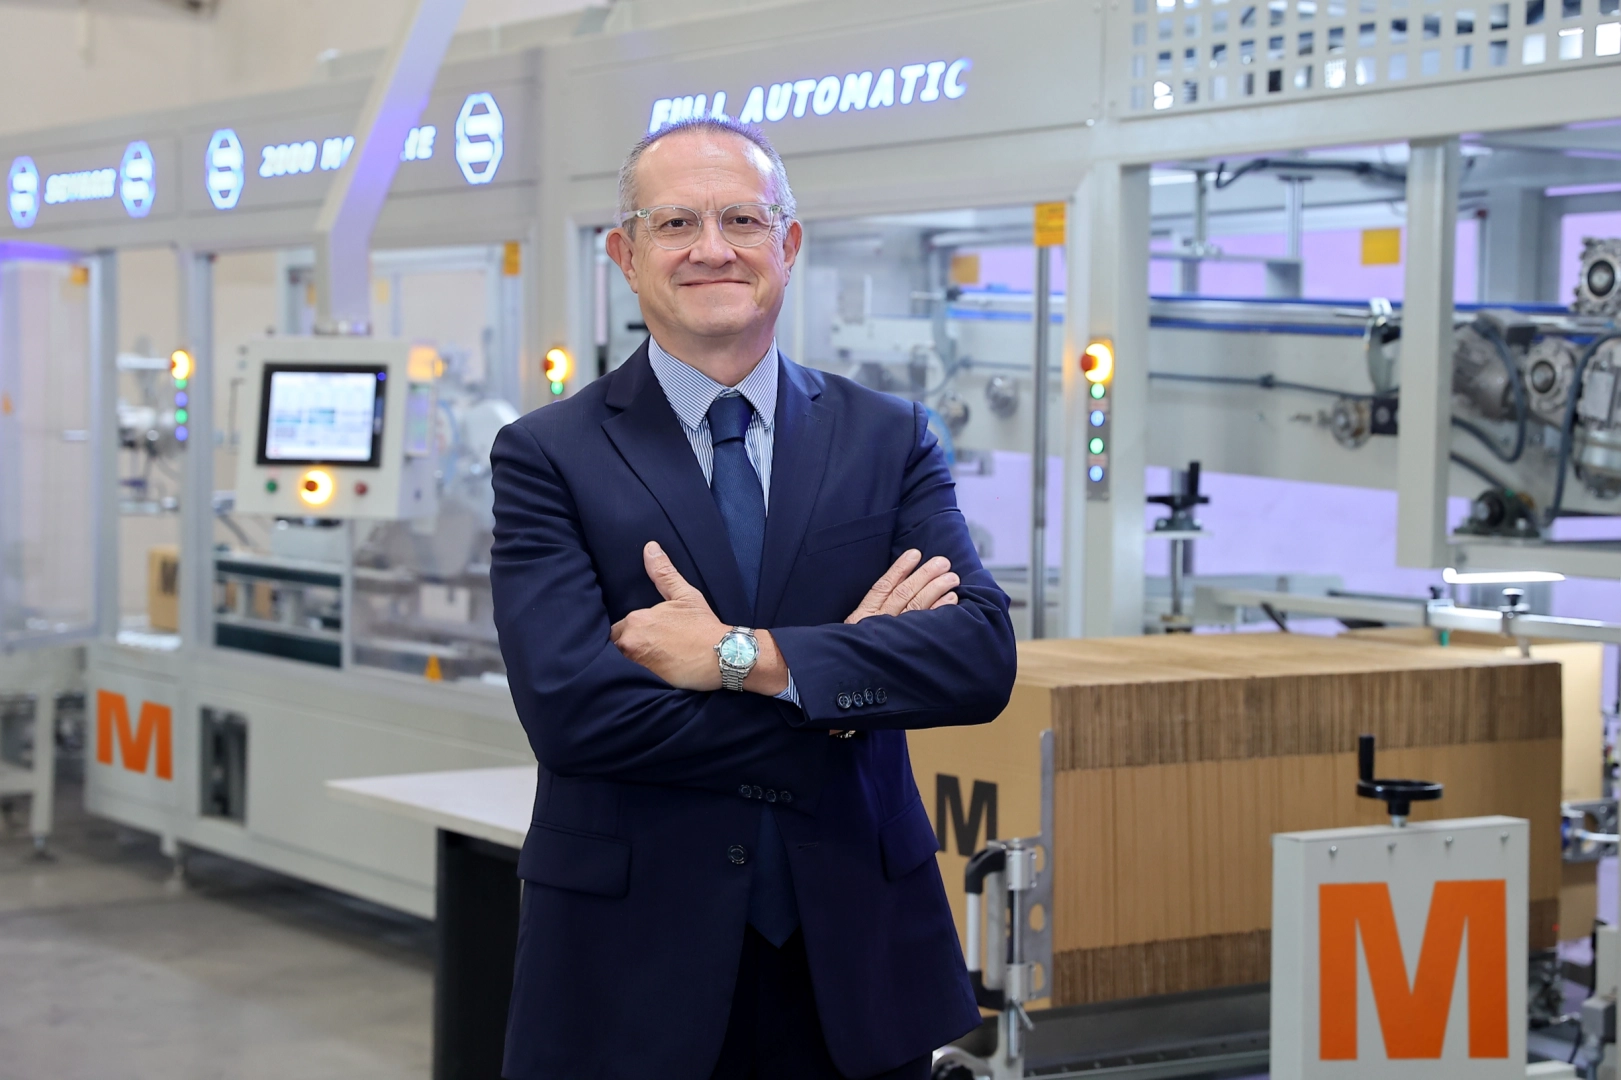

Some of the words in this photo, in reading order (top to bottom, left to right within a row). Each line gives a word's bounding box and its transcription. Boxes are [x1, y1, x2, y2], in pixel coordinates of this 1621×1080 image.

[738, 57, 973, 124] AUTOMATIC
[96, 688, 174, 781] M
[936, 772, 998, 858] M
[1318, 879, 1509, 1061] M
